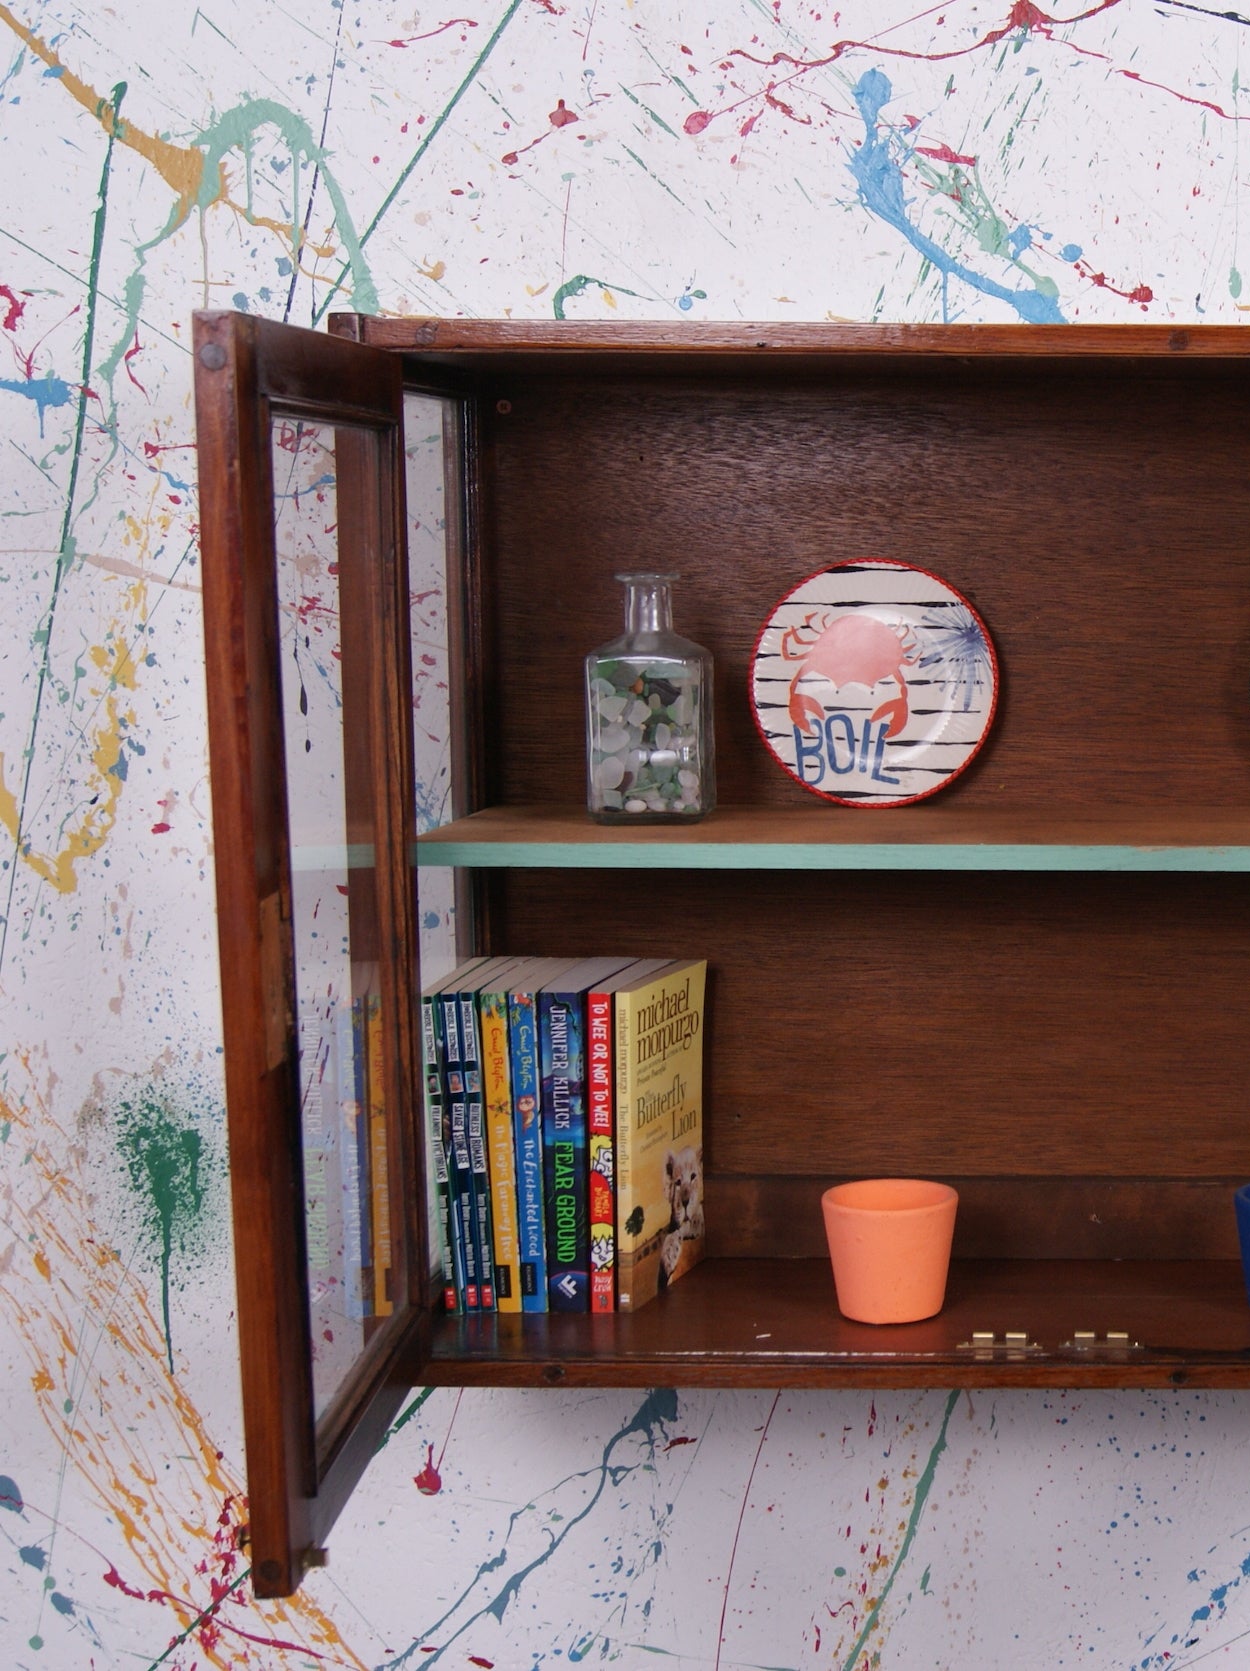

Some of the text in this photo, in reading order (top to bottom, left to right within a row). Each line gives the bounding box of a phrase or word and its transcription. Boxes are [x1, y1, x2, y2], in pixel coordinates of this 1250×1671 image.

[793, 714, 900, 785] BOIL
[592, 1018, 608, 1039] WEE
[637, 978, 690, 1036] michael
[592, 1043, 609, 1060] OR
[637, 1010, 699, 1064] morpurgo
[550, 1006, 570, 1129] JENNIFER KILLICK
[454, 1103, 464, 1127] SAVAGE
[593, 1104, 610, 1127] WEE!
[618, 1009, 630, 1190] michael morpurgo The Butterfly Lion
[636, 1074, 687, 1130] Butterfly
[672, 1108, 697, 1141] Lion
[471, 1138, 484, 1170] ROMANS
[496, 1142, 508, 1178] Magic
[555, 1141, 575, 1190] FEAR
[497, 1180, 511, 1232] Faraway
[523, 1161, 539, 1223] Enchanted
[501, 1235, 513, 1260] Tree
[527, 1227, 541, 1257] Wood
[555, 1194, 576, 1262] GROUND
